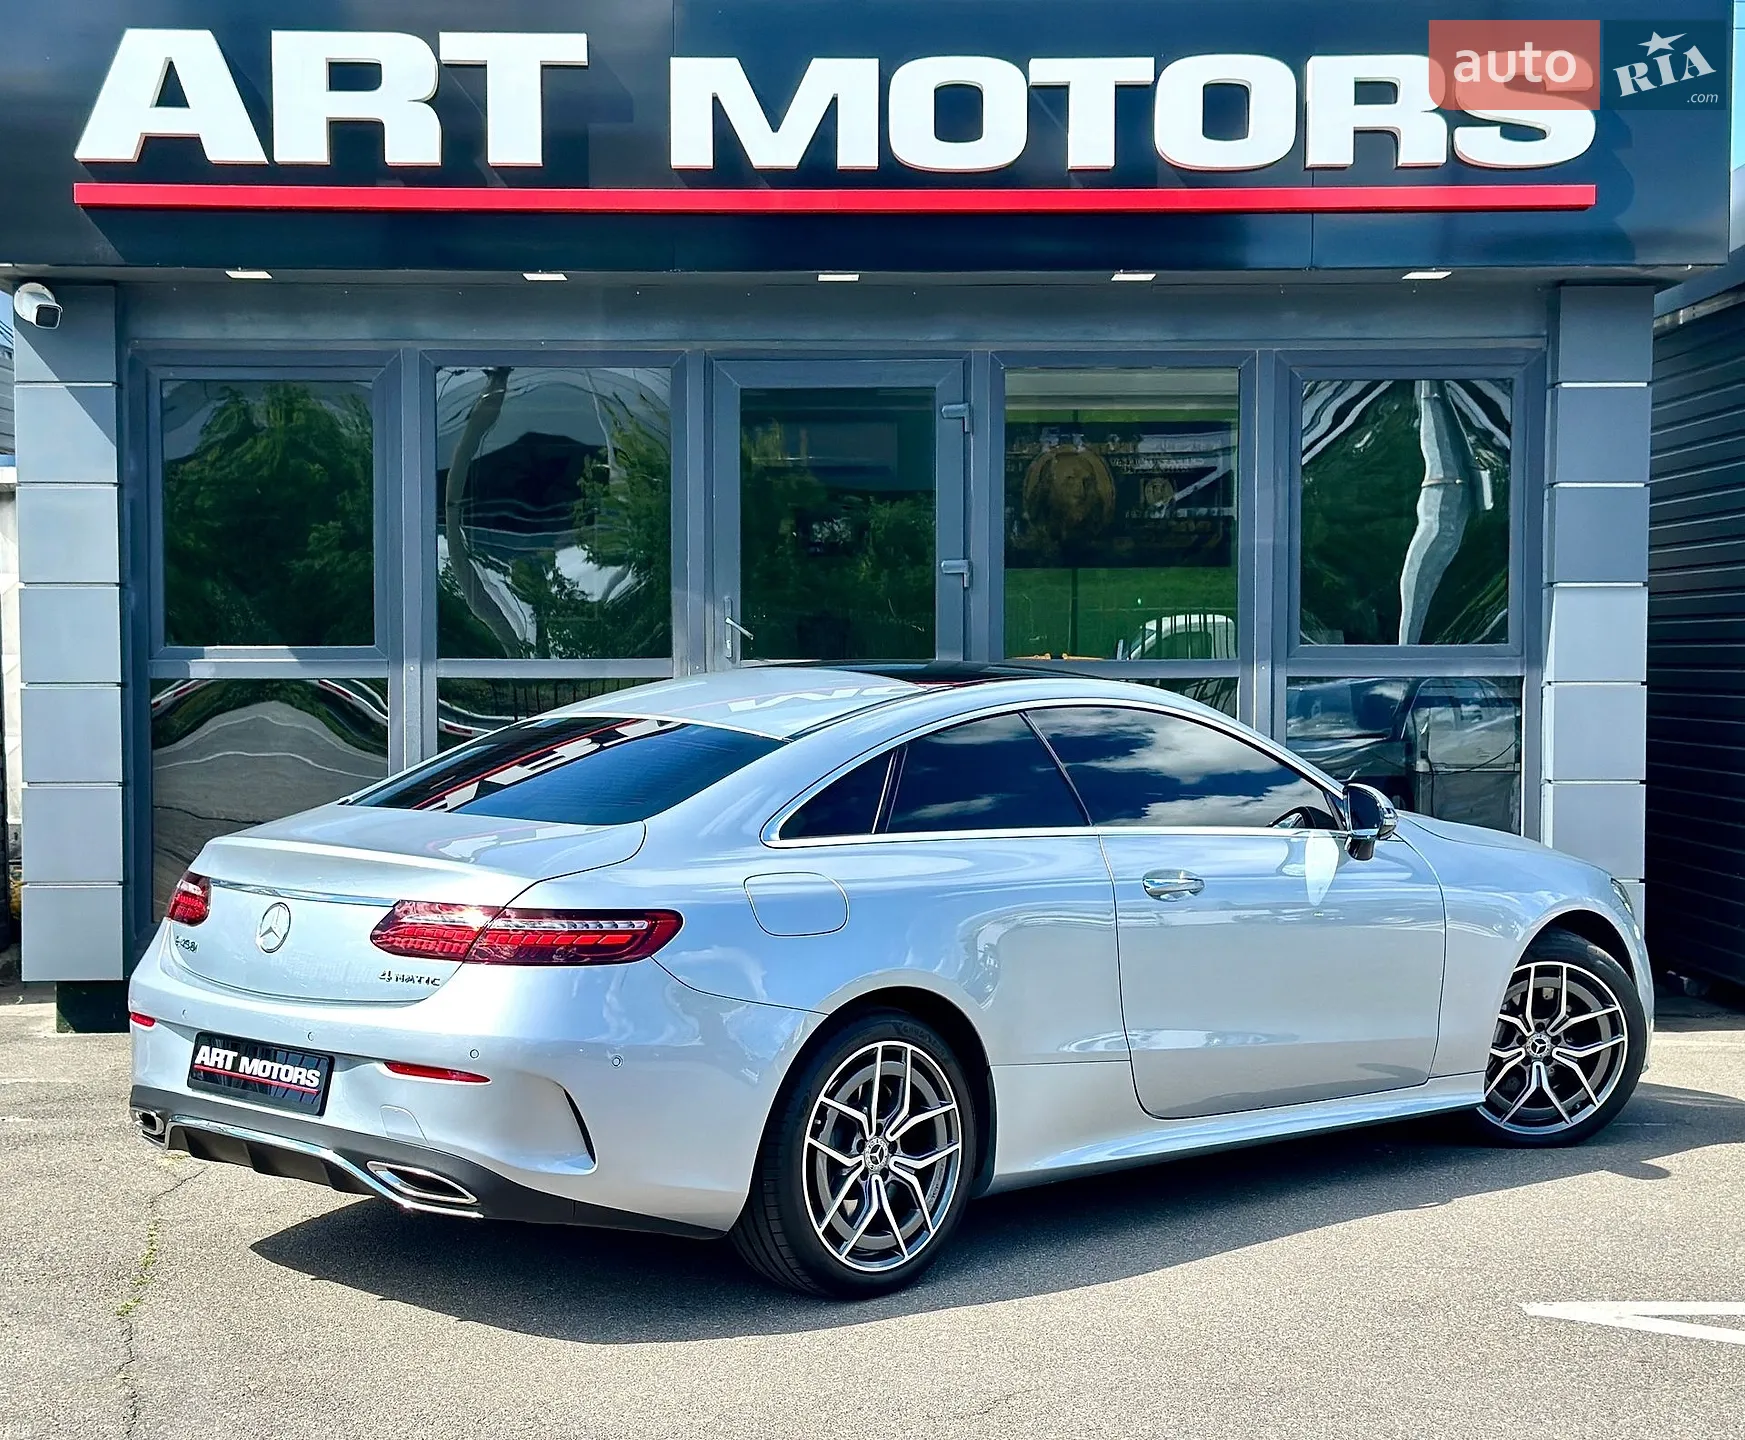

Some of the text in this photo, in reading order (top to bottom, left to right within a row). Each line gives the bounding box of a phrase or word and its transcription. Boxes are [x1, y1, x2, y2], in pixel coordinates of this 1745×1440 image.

[74, 29, 1597, 170] ART MOTORS
[194, 1045, 321, 1088] ART MOTORS
